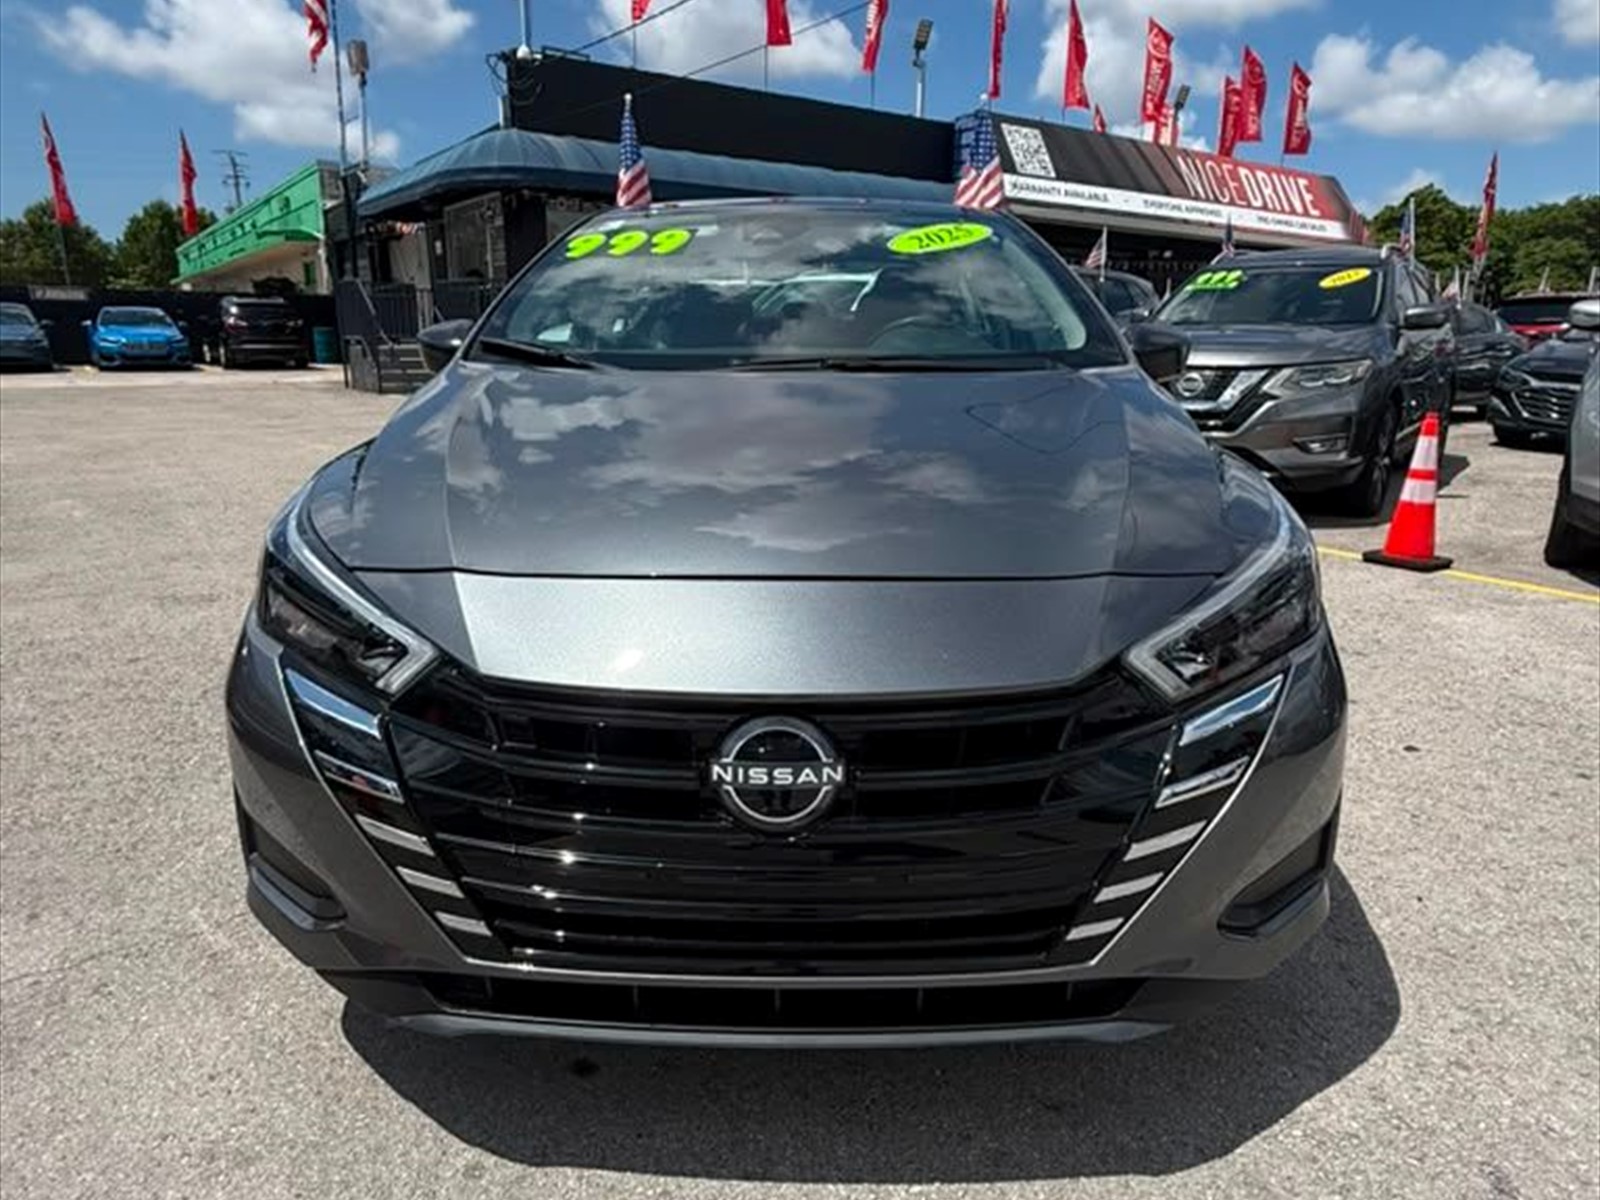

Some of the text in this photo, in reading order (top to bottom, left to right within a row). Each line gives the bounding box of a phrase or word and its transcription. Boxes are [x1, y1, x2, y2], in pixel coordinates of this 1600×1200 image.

[1177, 154, 1321, 216] NICEDRIVE
[565, 228, 691, 259] 999
[711, 764, 843, 785] NISSAN
